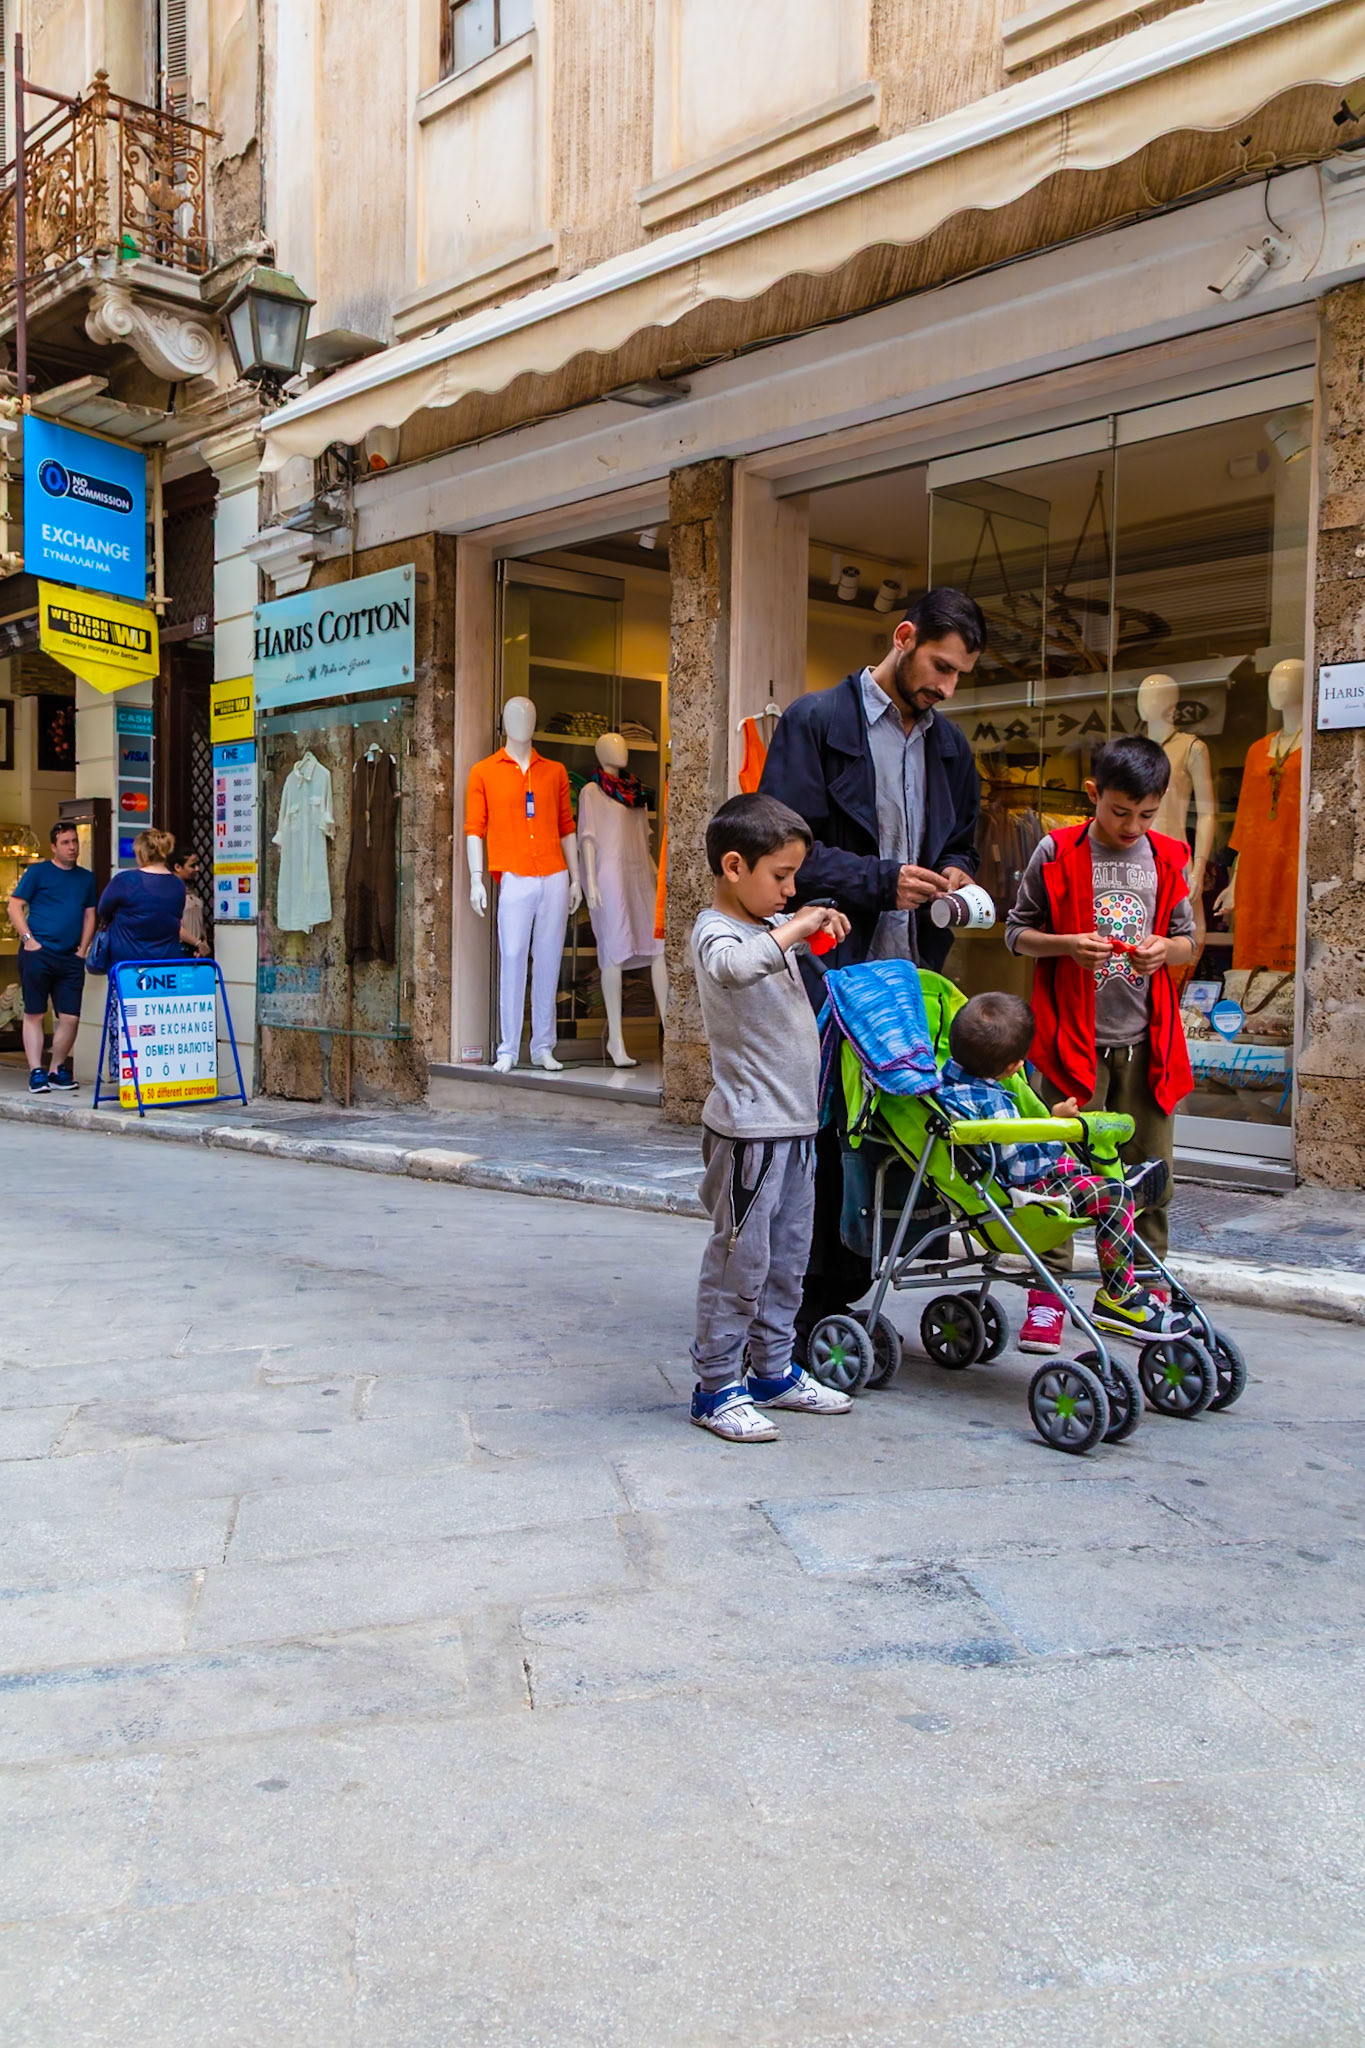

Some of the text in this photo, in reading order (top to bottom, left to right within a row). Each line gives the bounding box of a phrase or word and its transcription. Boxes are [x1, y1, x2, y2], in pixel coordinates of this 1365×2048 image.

[72, 475, 88, 488] NO
[72, 485, 129, 510] COMMISSION
[42, 523, 130, 562] EXCHANGE
[43, 547, 111, 573] ΣΥΝΑΛΛΑΓΜΑ
[50, 607, 109, 631] WESTERN
[69, 622, 147, 650] UNION WU
[253, 598, 410, 660] HARIS COTTON
[63, 638, 140, 661] moving money for better
[1325, 687, 1365, 700] HARIS
[119, 713, 152, 724] CASH
[122, 748, 149, 762] VISA
[1125, 862, 1142, 870] FOR
[136, 973, 177, 991] ONE
[144, 1001, 213, 1016] ΣΥΝΑΛΛΑΓΜΑ
[160, 1021, 213, 1035] EXCHANGE
[145, 1041, 214, 1057] ОБМЕН ВАЛЮТЫ
[122, 1083, 215, 1102] We by 50 different currencies
